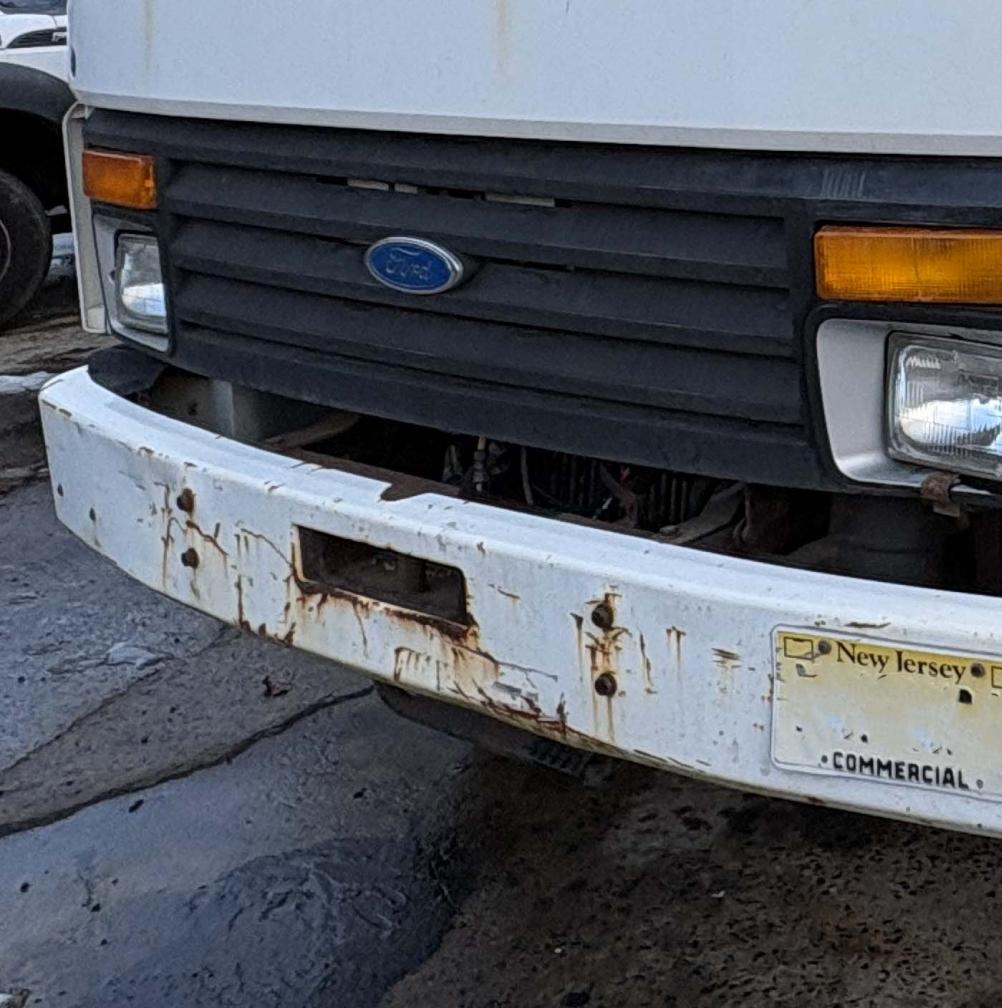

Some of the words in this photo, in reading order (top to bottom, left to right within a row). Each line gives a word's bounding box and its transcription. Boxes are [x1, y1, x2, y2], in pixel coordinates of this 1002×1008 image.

[835, 641, 890, 674] New
[896, 650, 967, 685] Jersey
[832, 751, 970, 790] COMMERCIAL
